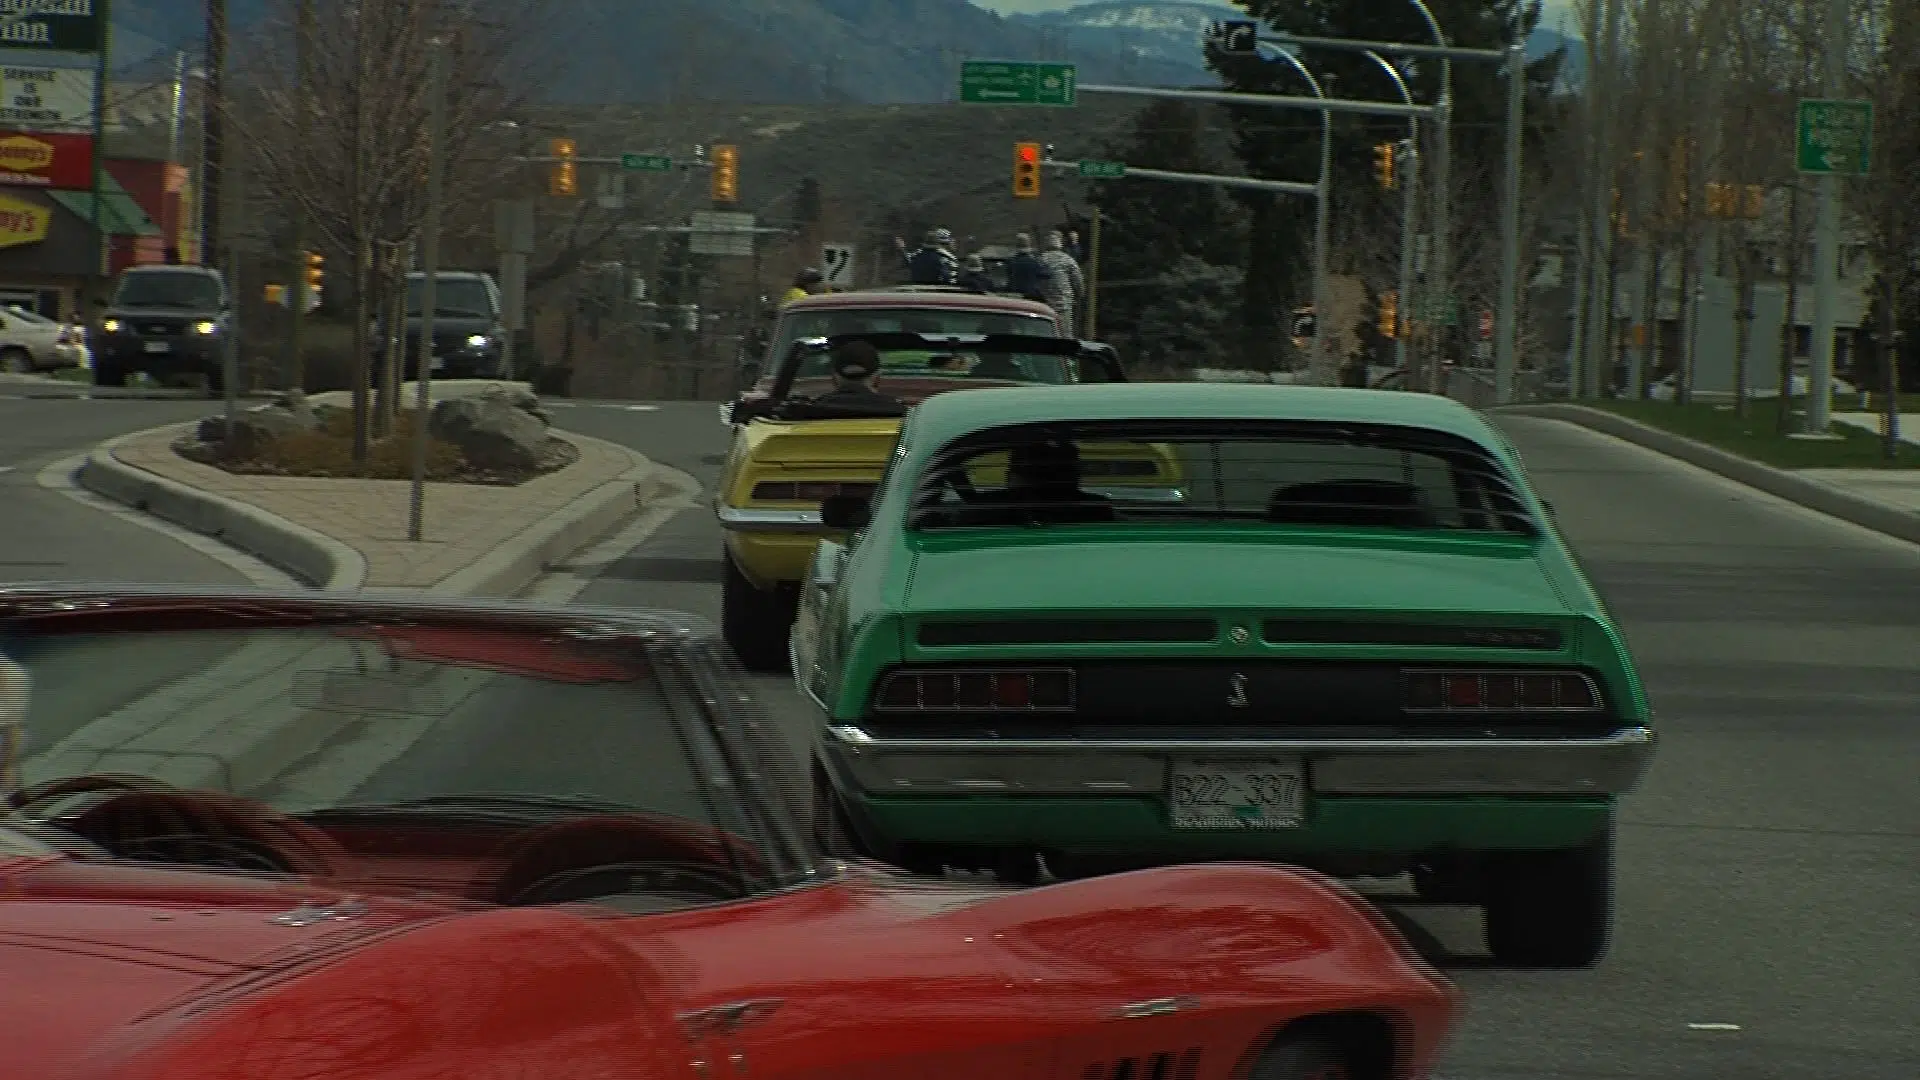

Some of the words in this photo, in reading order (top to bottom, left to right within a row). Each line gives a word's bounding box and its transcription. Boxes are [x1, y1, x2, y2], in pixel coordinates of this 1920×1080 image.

[3, 67, 56, 82] SERVICE
[24, 83, 37, 95] IS
[1175, 773, 1299, 805] B22-337
[1247, 817, 1299, 828] MOTORS
